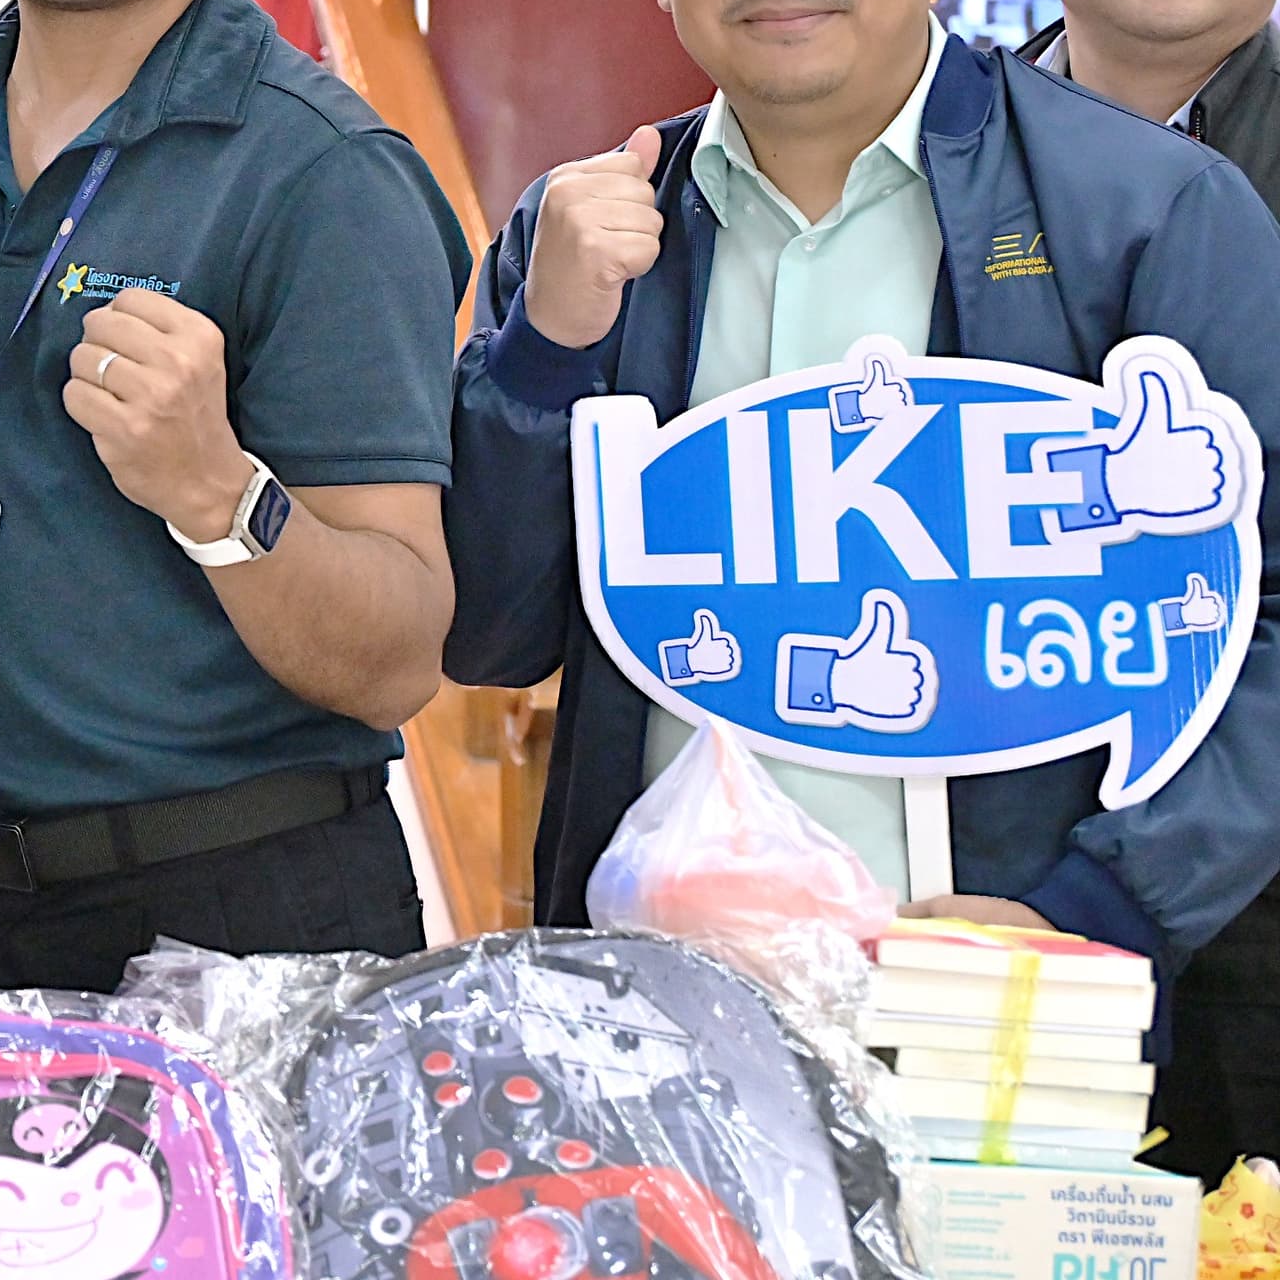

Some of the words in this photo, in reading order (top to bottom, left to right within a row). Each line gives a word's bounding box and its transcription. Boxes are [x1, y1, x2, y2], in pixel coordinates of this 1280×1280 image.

[596, 399, 1103, 587] LIKE
[985, 598, 1168, 689] เลย
[1058, 1230, 1087, 1245] ตรา
